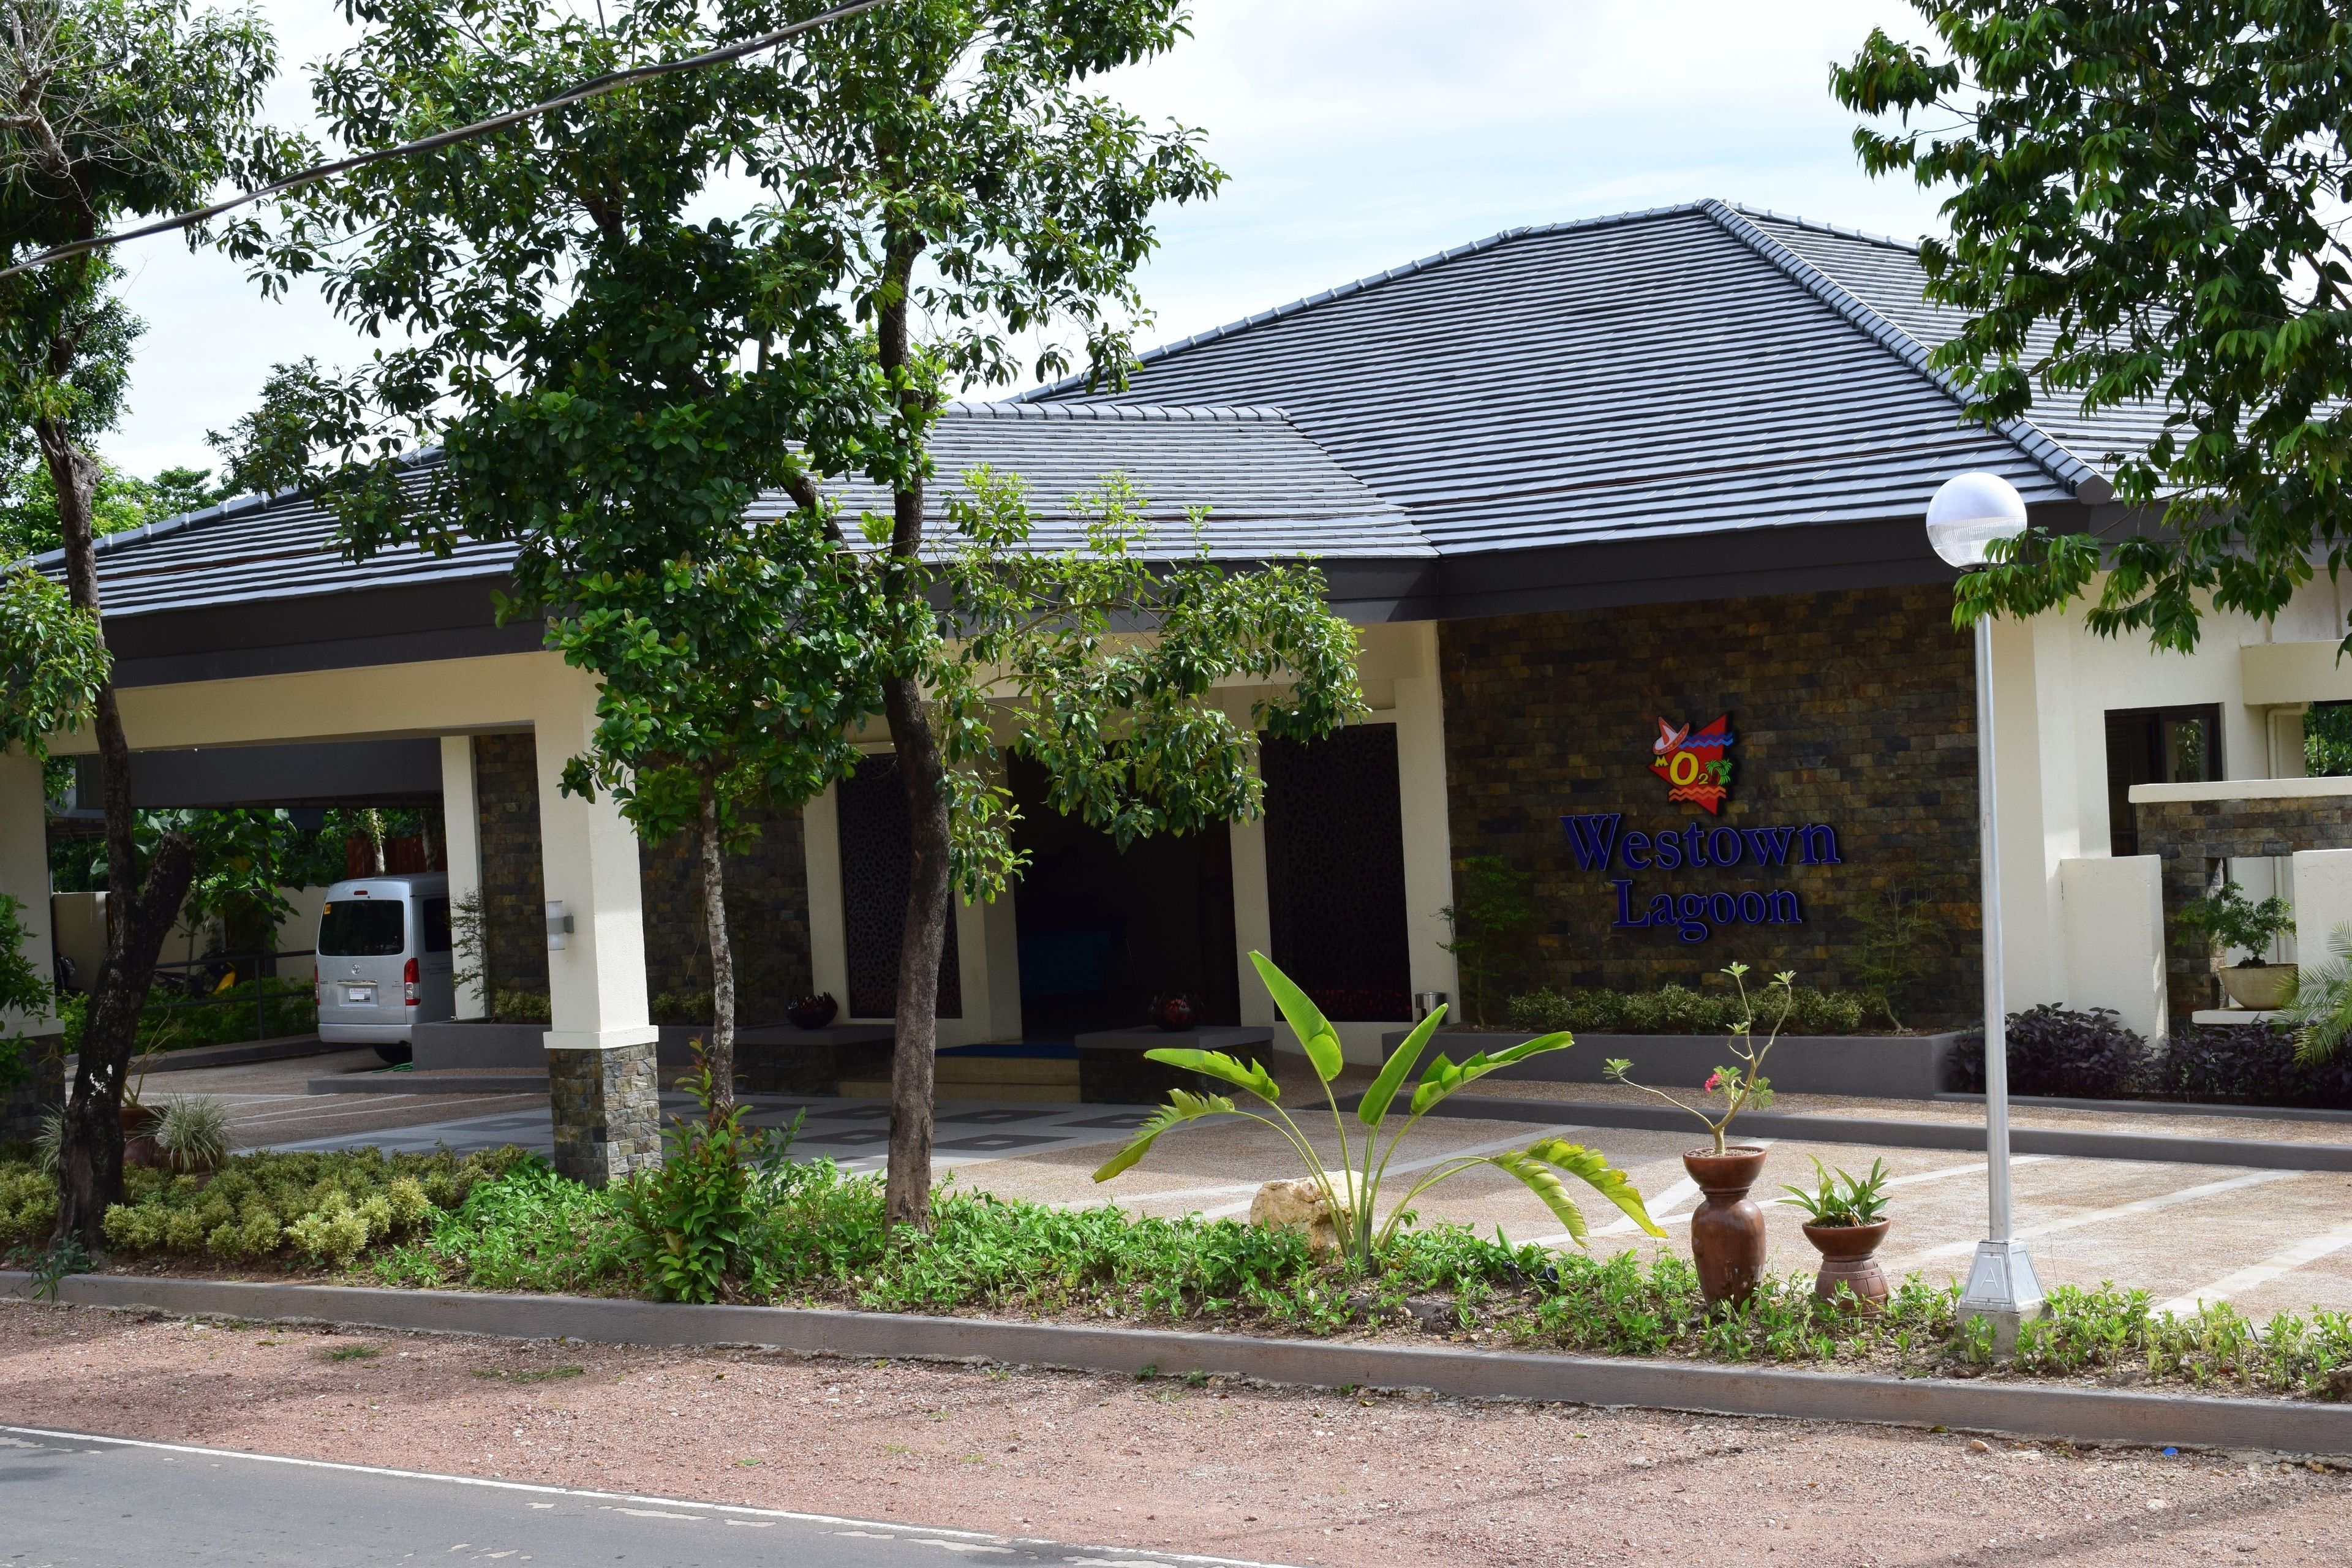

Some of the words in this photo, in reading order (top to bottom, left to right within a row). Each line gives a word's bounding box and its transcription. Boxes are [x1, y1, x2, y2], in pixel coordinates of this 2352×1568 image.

[1559, 813, 1841, 872] Westown
[1611, 880, 1802, 944] Lagoon
[1980, 1267, 1998, 1289] A
